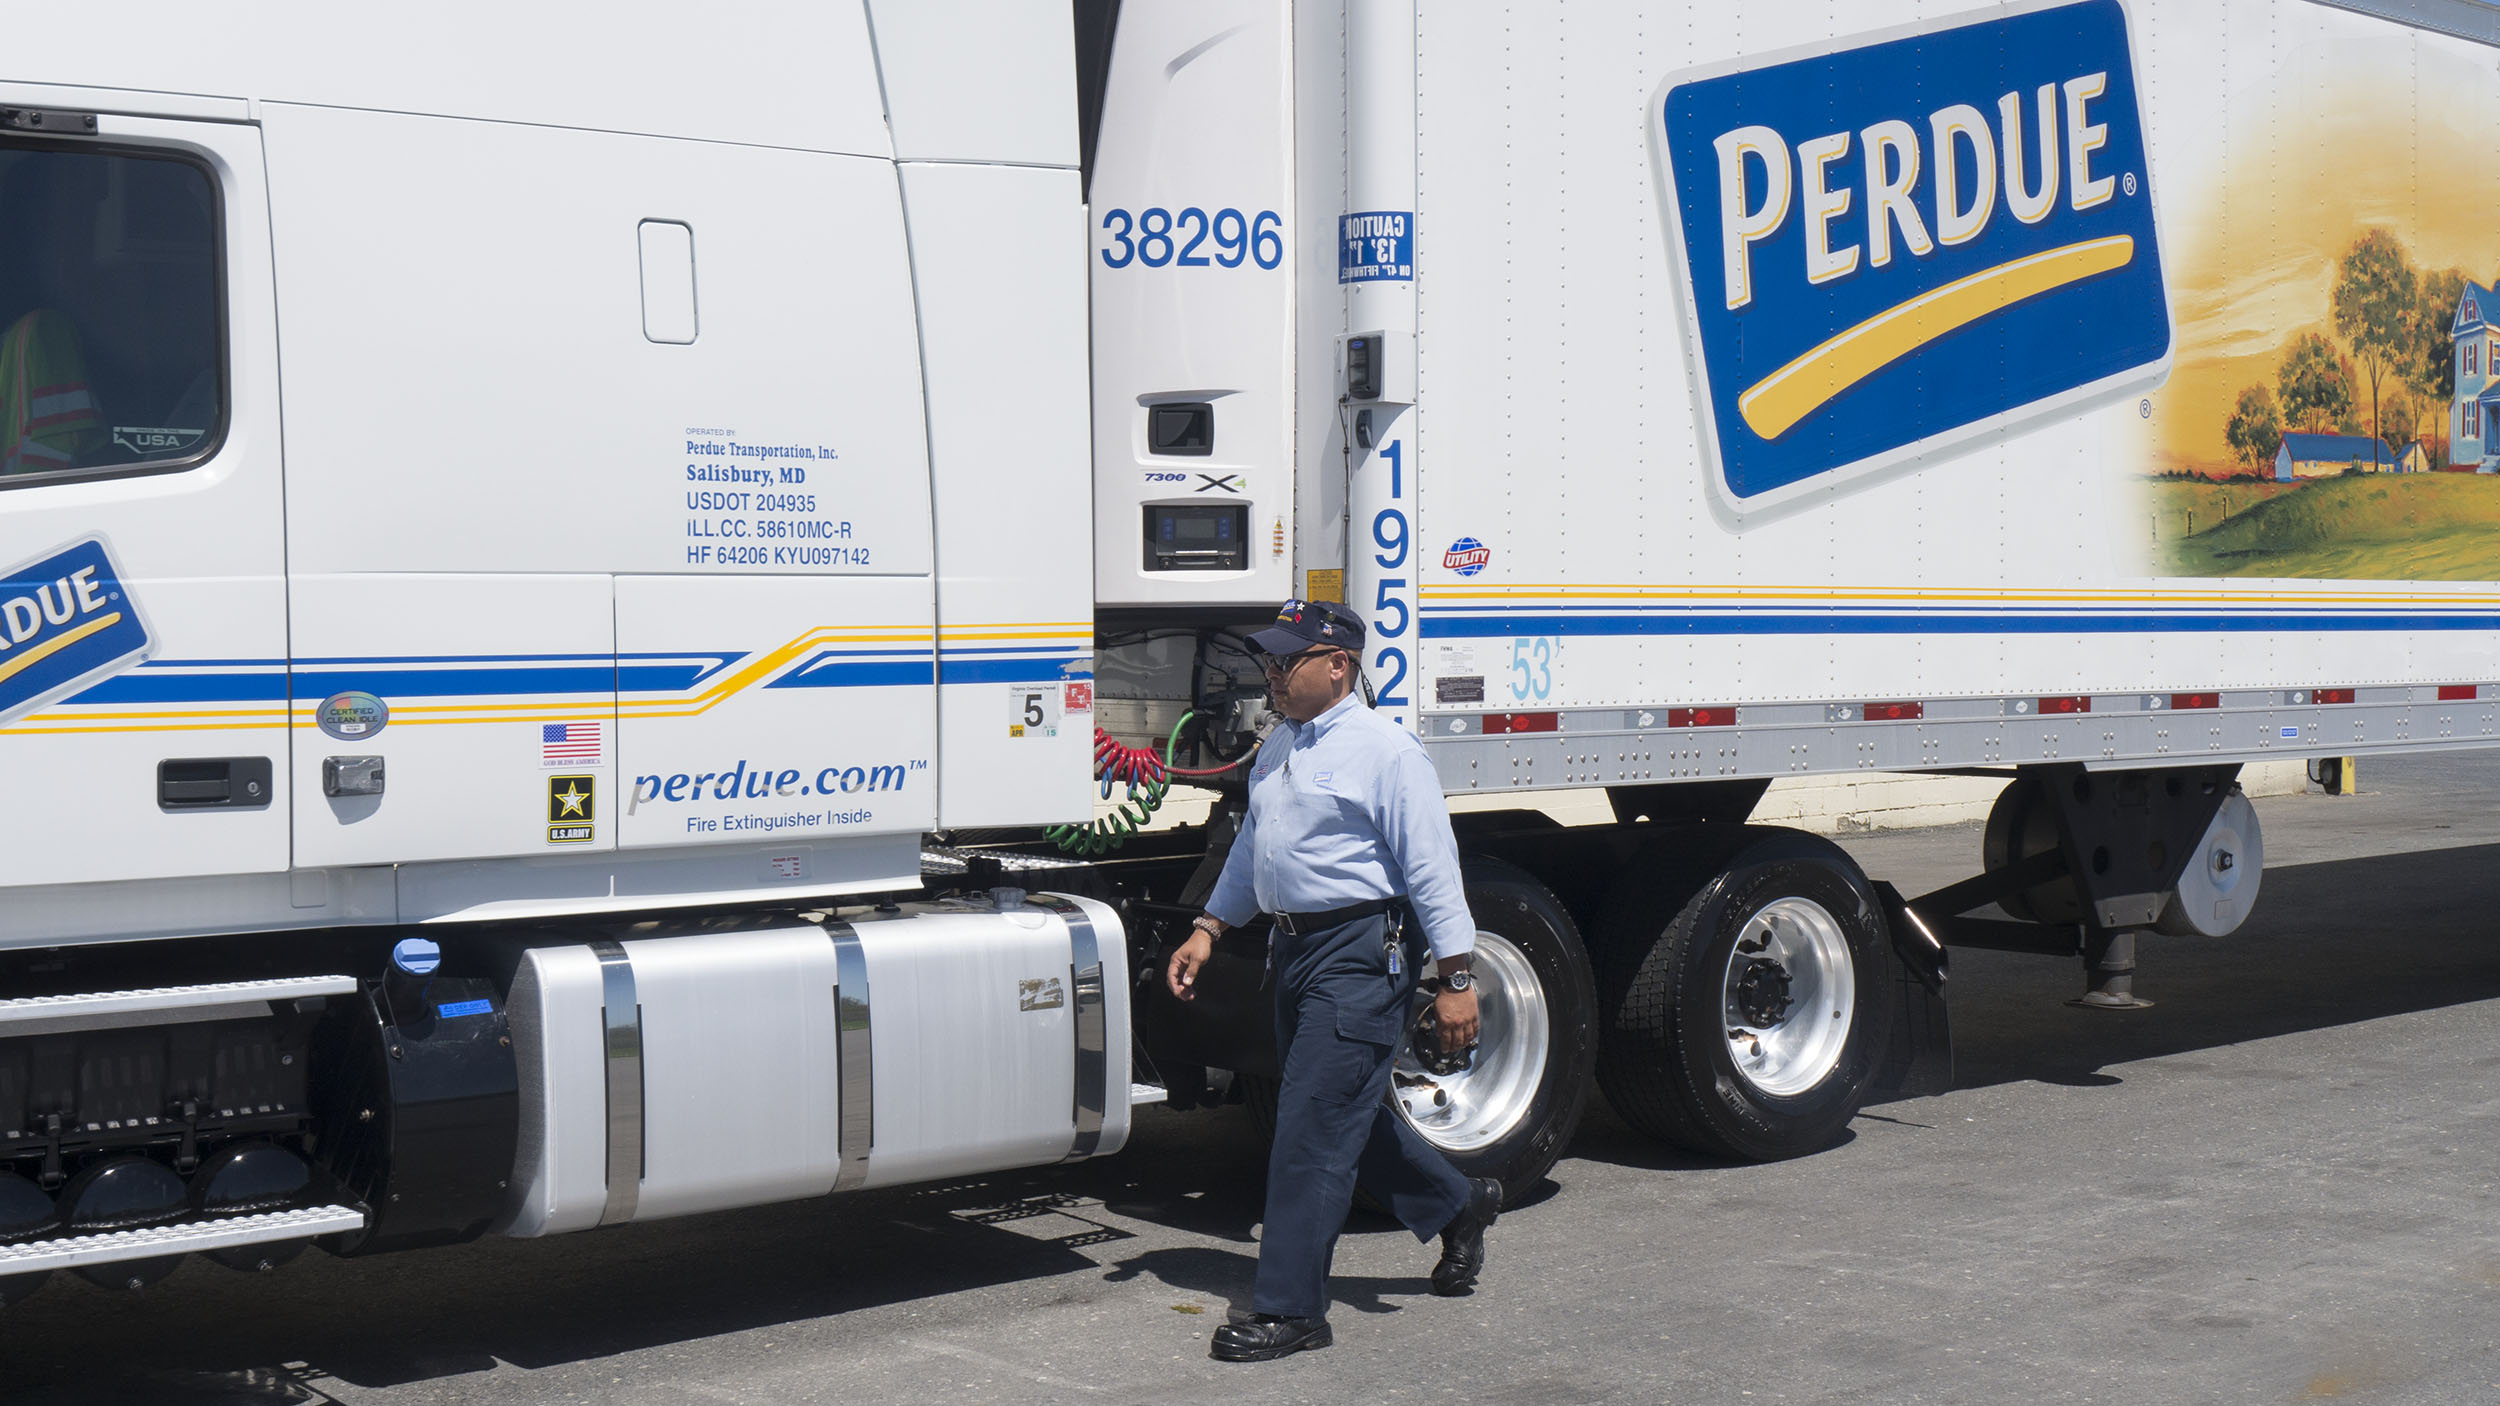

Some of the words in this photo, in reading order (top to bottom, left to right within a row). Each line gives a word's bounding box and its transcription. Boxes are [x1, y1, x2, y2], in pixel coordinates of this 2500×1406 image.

[1713, 71, 2116, 311] PERDUE
[1102, 207, 1283, 270] 38296
[136, 434, 180, 447] USA
[685, 427, 725, 436] OPERATED
[686, 441, 726, 456] Perdue
[729, 442, 816, 461] Transportation,
[818, 445, 839, 460] Inc.
[686, 464, 775, 487] Salisbury,
[779, 467, 806, 484] MD
[1144, 473, 1187, 482] 7300
[687, 492, 751, 511] USDOT
[756, 494, 816, 512] 204935
[756, 520, 852, 539] 58610MC-R
[687, 546, 711, 564] HF
[717, 546, 768, 564] 64206
[774, 547, 870, 565] KYU097142
[1445, 549, 1489, 567] UTILITY
[1373, 440, 1409, 725] 1952
[0, 565, 107, 650] DUE
[330, 707, 374, 715] CERTIFIED
[360, 715, 378, 723] IDLE
[1024, 694, 1044, 727] 5
[687, 816, 718, 832] Fire
[723, 811, 822, 832] Extinguisher
[827, 808, 873, 825] Inside
